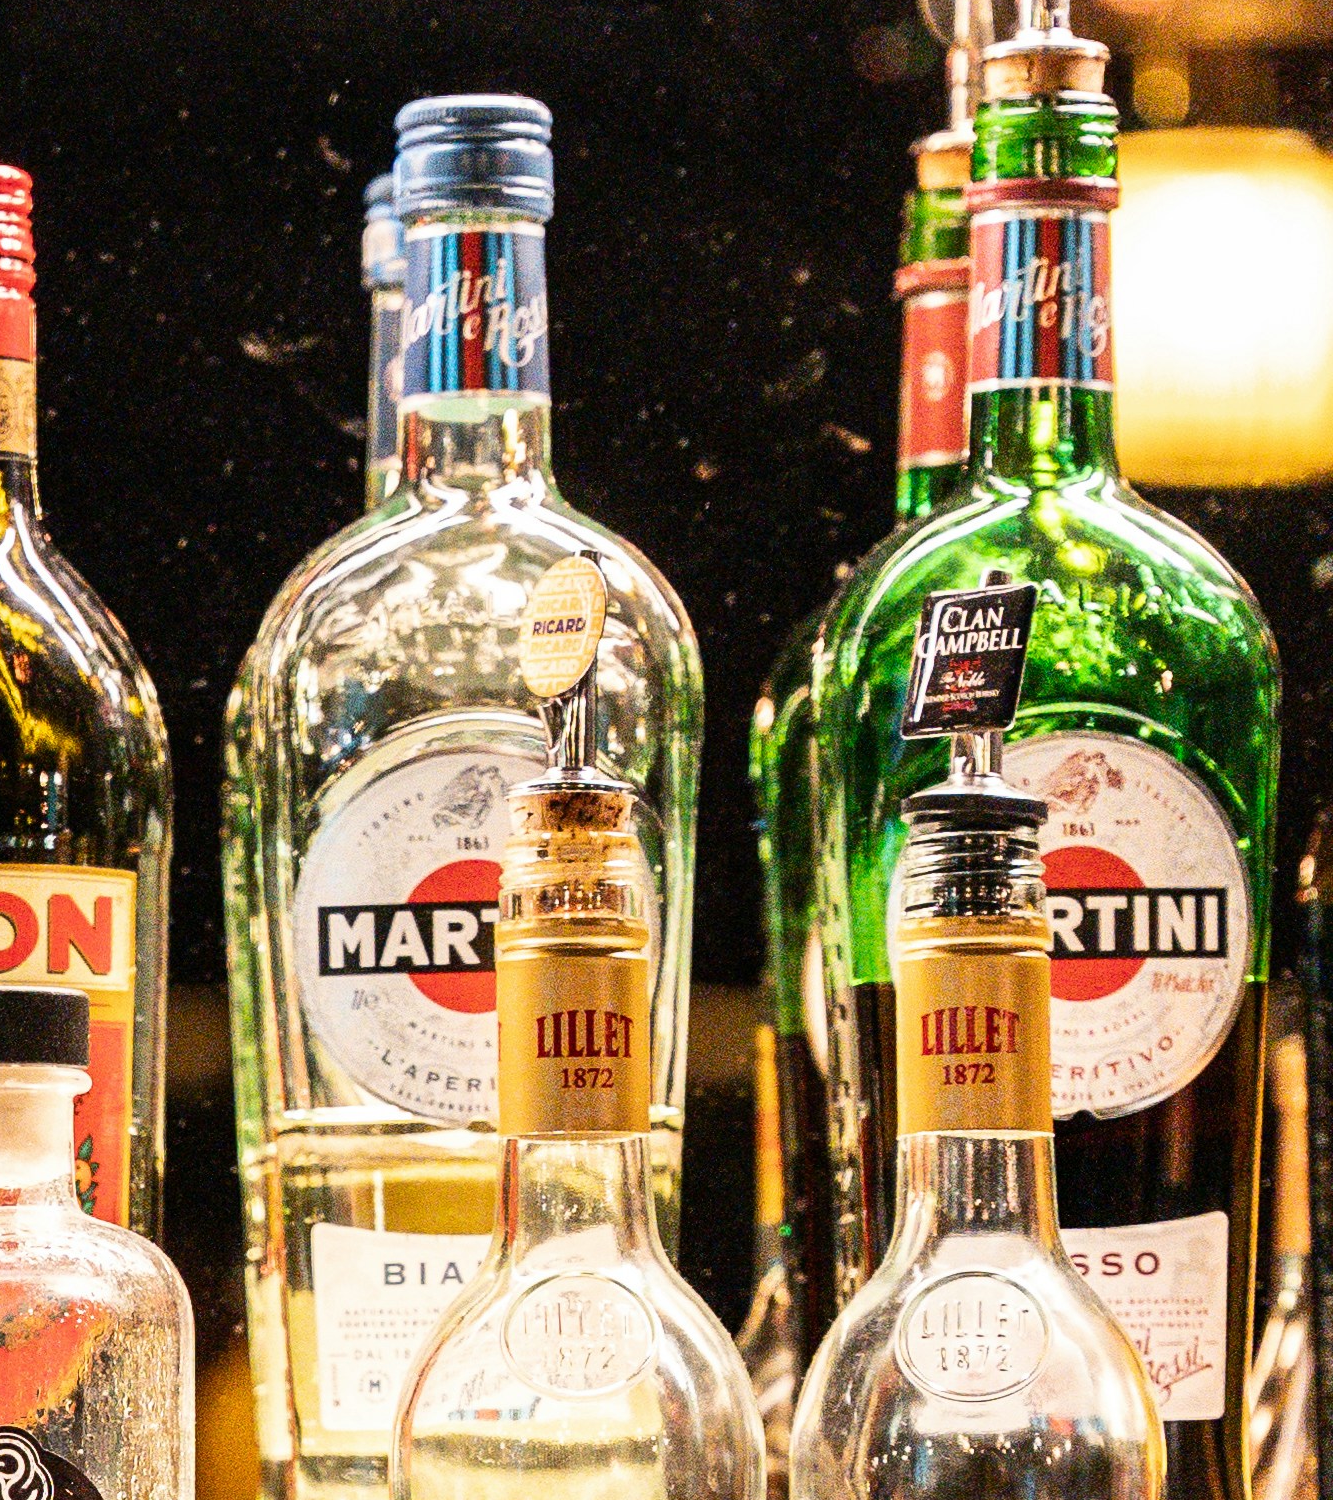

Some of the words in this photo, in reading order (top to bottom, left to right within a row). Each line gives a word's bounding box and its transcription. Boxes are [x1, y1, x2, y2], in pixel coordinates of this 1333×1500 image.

[532, 618, 586, 638] RICARD
[940, 605, 1005, 634] CLAN
[916, 627, 1024, 659] CAMPBELL
[1045, 893, 1220, 953] RTINI
[535, 1010, 634, 1060] LILLET
[920, 1005, 1021, 1059] LILLET
[560, 1066, 614, 1090] 1872
[942, 1062, 996, 1088] 1872
